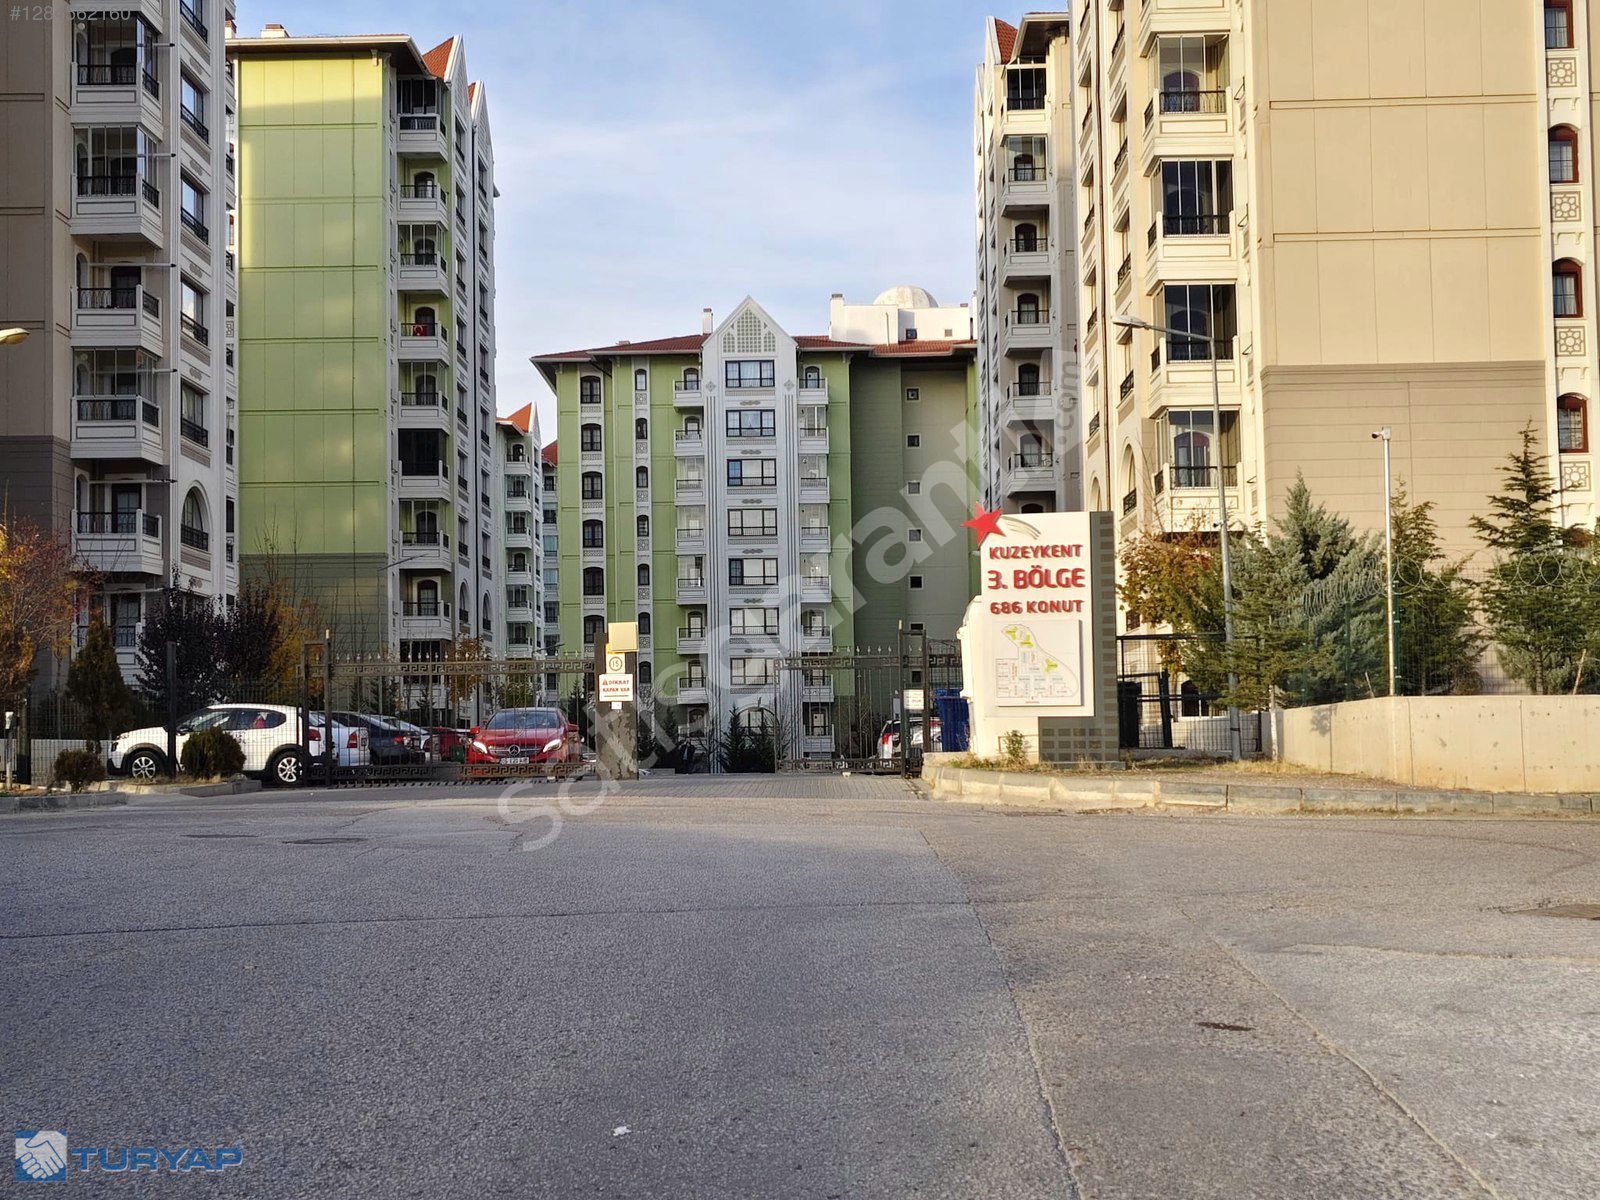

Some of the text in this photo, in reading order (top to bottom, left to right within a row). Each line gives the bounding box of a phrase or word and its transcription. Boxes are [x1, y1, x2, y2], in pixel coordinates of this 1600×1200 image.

[989, 543, 1084, 560] KUZEYKENT
[988, 565, 1086, 590] 3. BÖLGE
[990, 599, 1084, 614] 686 KONUT
